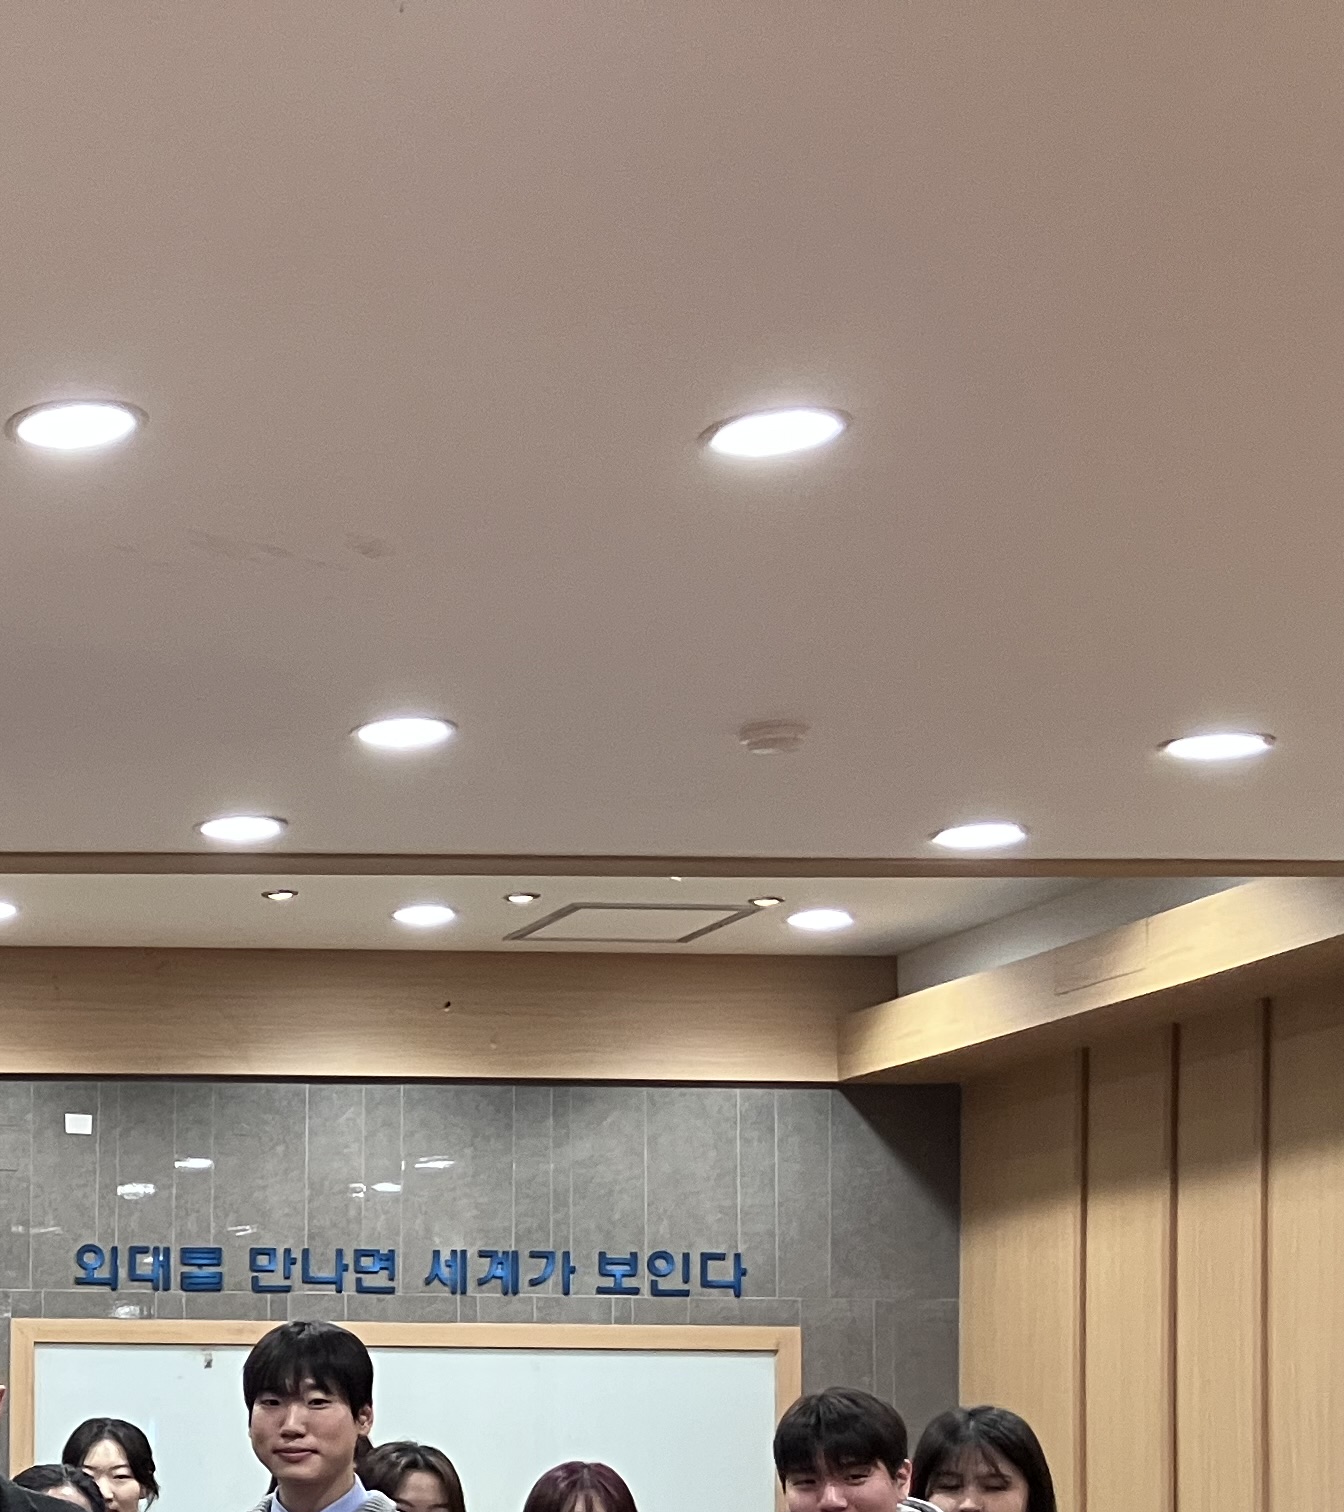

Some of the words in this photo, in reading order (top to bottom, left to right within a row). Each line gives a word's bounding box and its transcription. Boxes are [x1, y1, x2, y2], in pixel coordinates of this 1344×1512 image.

[74, 1243, 224, 1293] 외대를
[250, 1248, 395, 1294] 만나면
[424, 1249, 576, 1296] 세계가
[595, 1250, 747, 1298] 보인다
